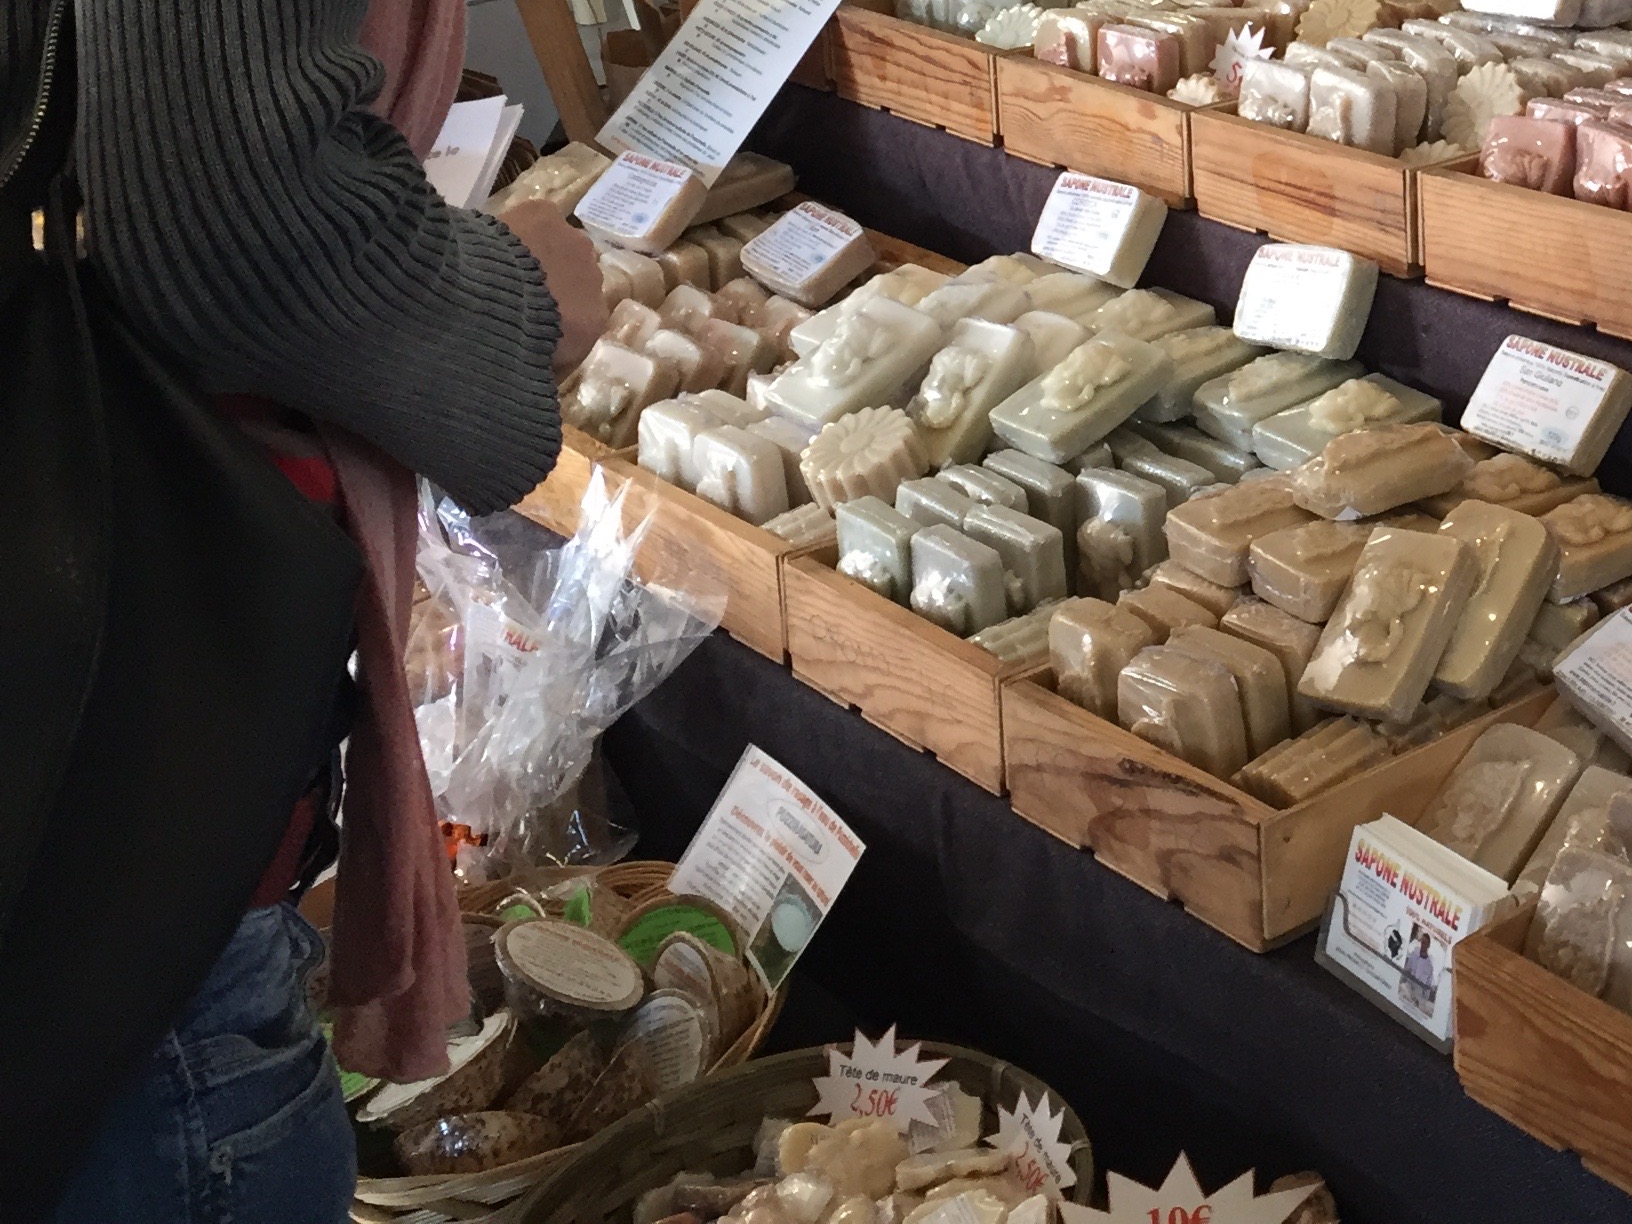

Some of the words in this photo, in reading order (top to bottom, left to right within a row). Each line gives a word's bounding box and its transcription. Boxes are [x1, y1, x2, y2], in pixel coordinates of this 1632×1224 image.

[1354, 837, 1402, 889] SAPONE
[1399, 870, 1463, 932] NUSTRALE
[839, 1064, 863, 1080] Tête
[865, 1069, 879, 1082] de
[882, 1071, 919, 1087] maure
